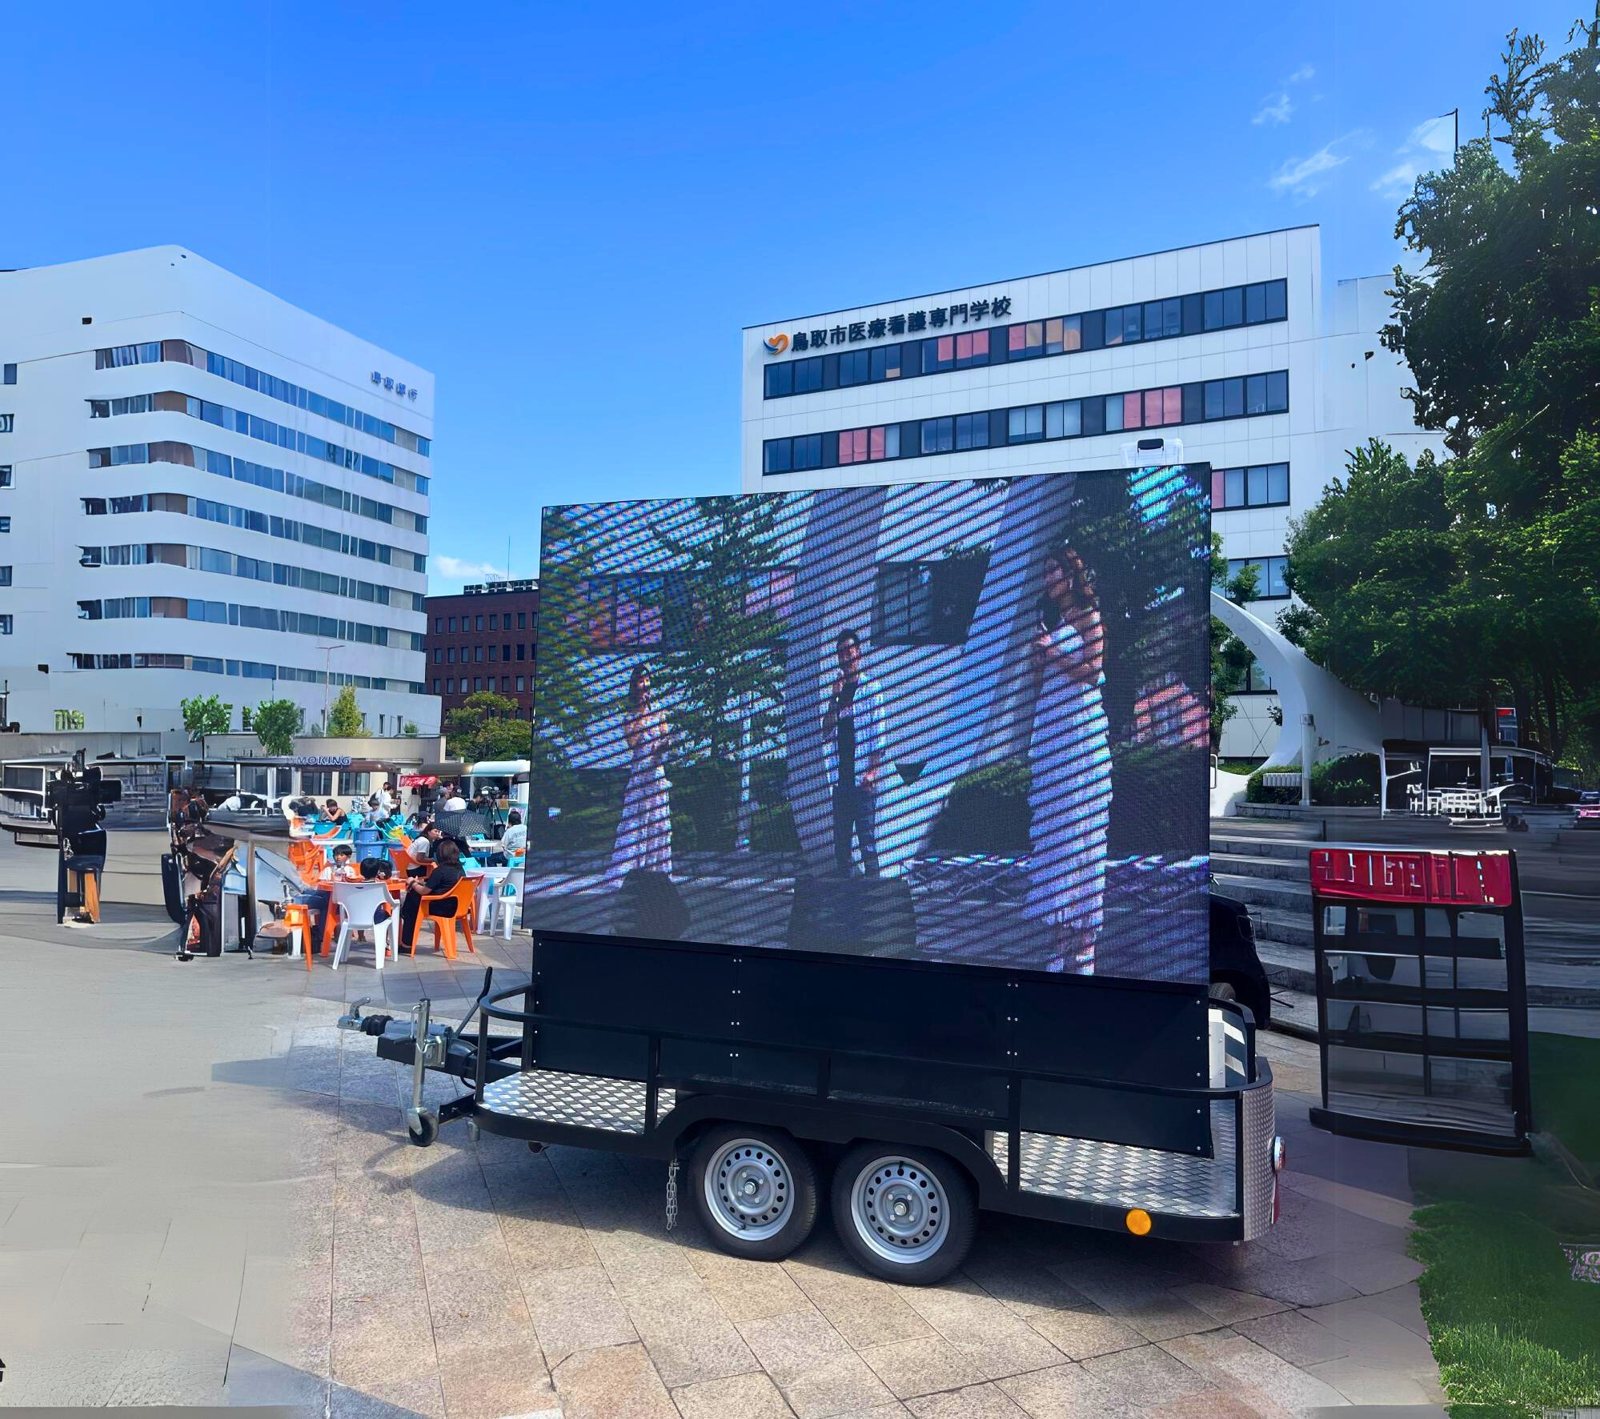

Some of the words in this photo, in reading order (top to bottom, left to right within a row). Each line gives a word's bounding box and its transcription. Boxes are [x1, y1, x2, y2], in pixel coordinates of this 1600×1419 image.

[791, 296, 1012, 352] 鳥取市医療看護専門学校
